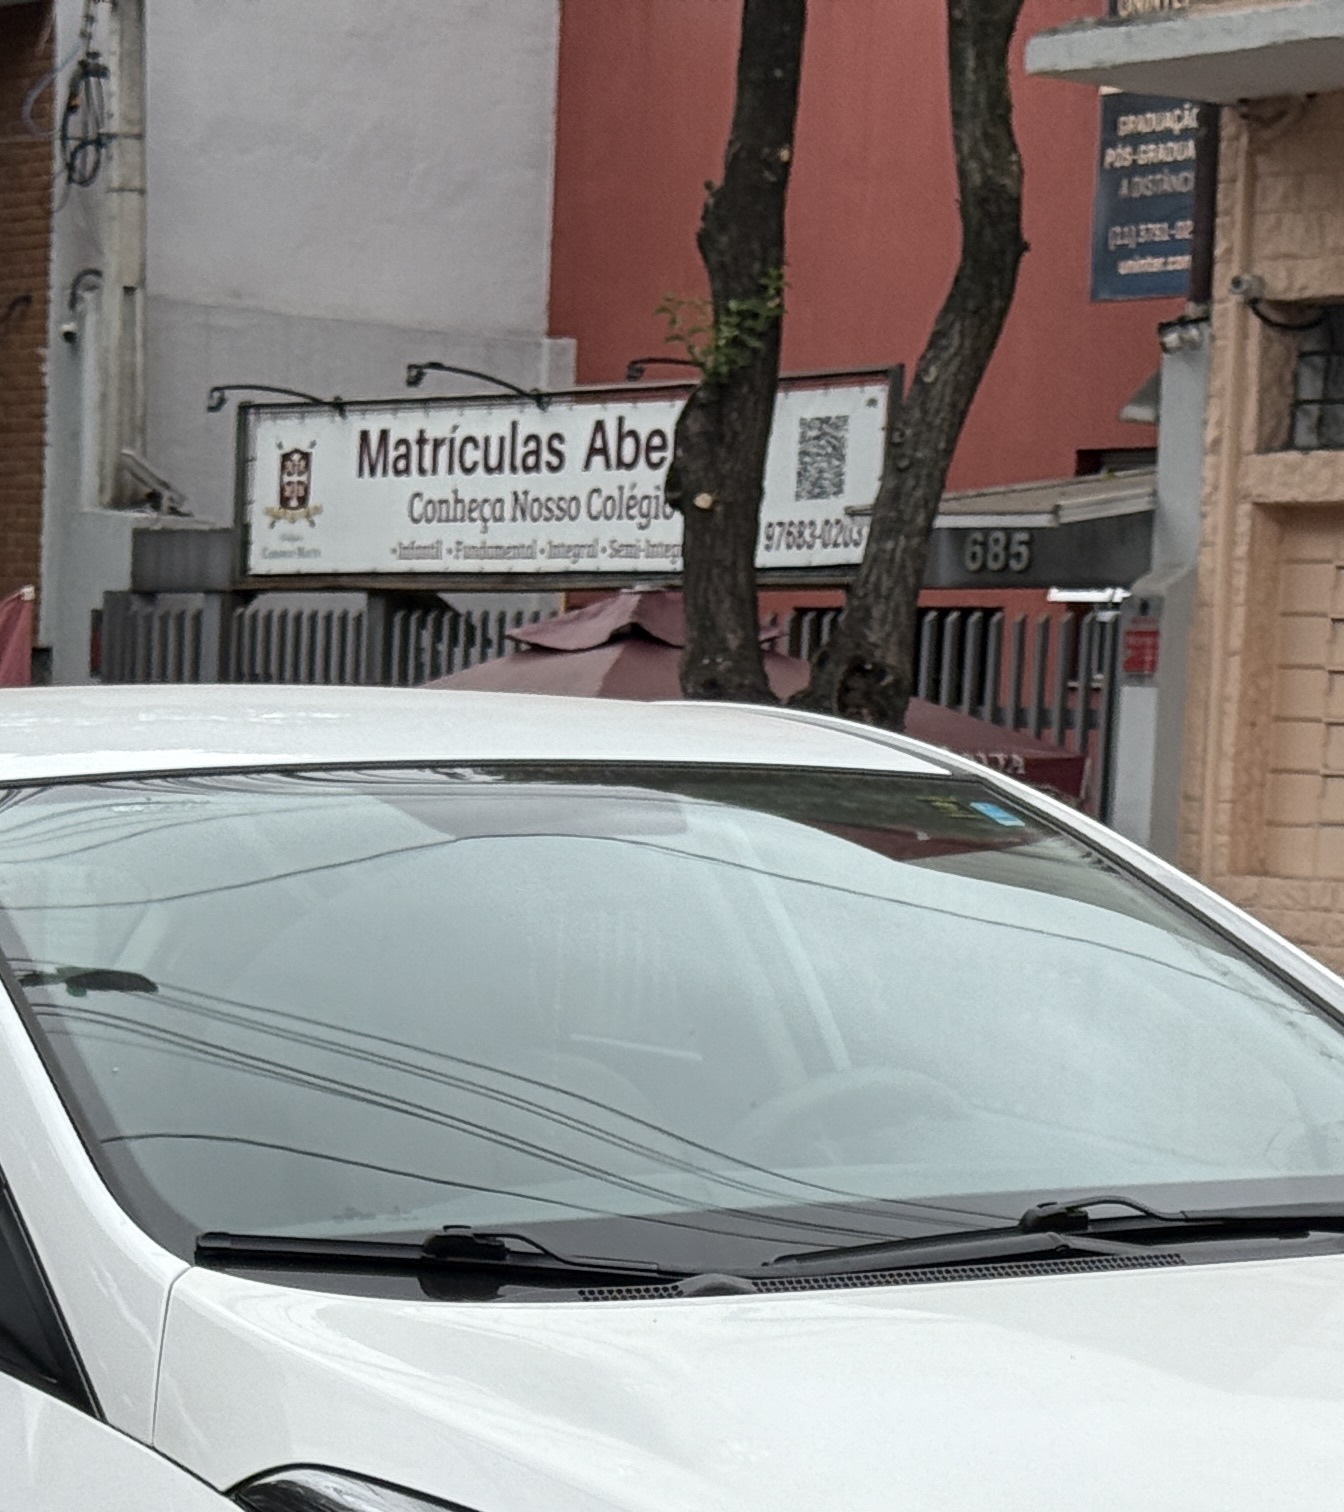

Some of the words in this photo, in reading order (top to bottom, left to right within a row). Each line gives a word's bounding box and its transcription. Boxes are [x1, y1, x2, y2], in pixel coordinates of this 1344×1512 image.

[357, 420, 566, 478] Matrículas
[409, 488, 505, 534] Conheça
[511, 489, 582, 523] Nosso
[964, 531, 1032, 572] 685
